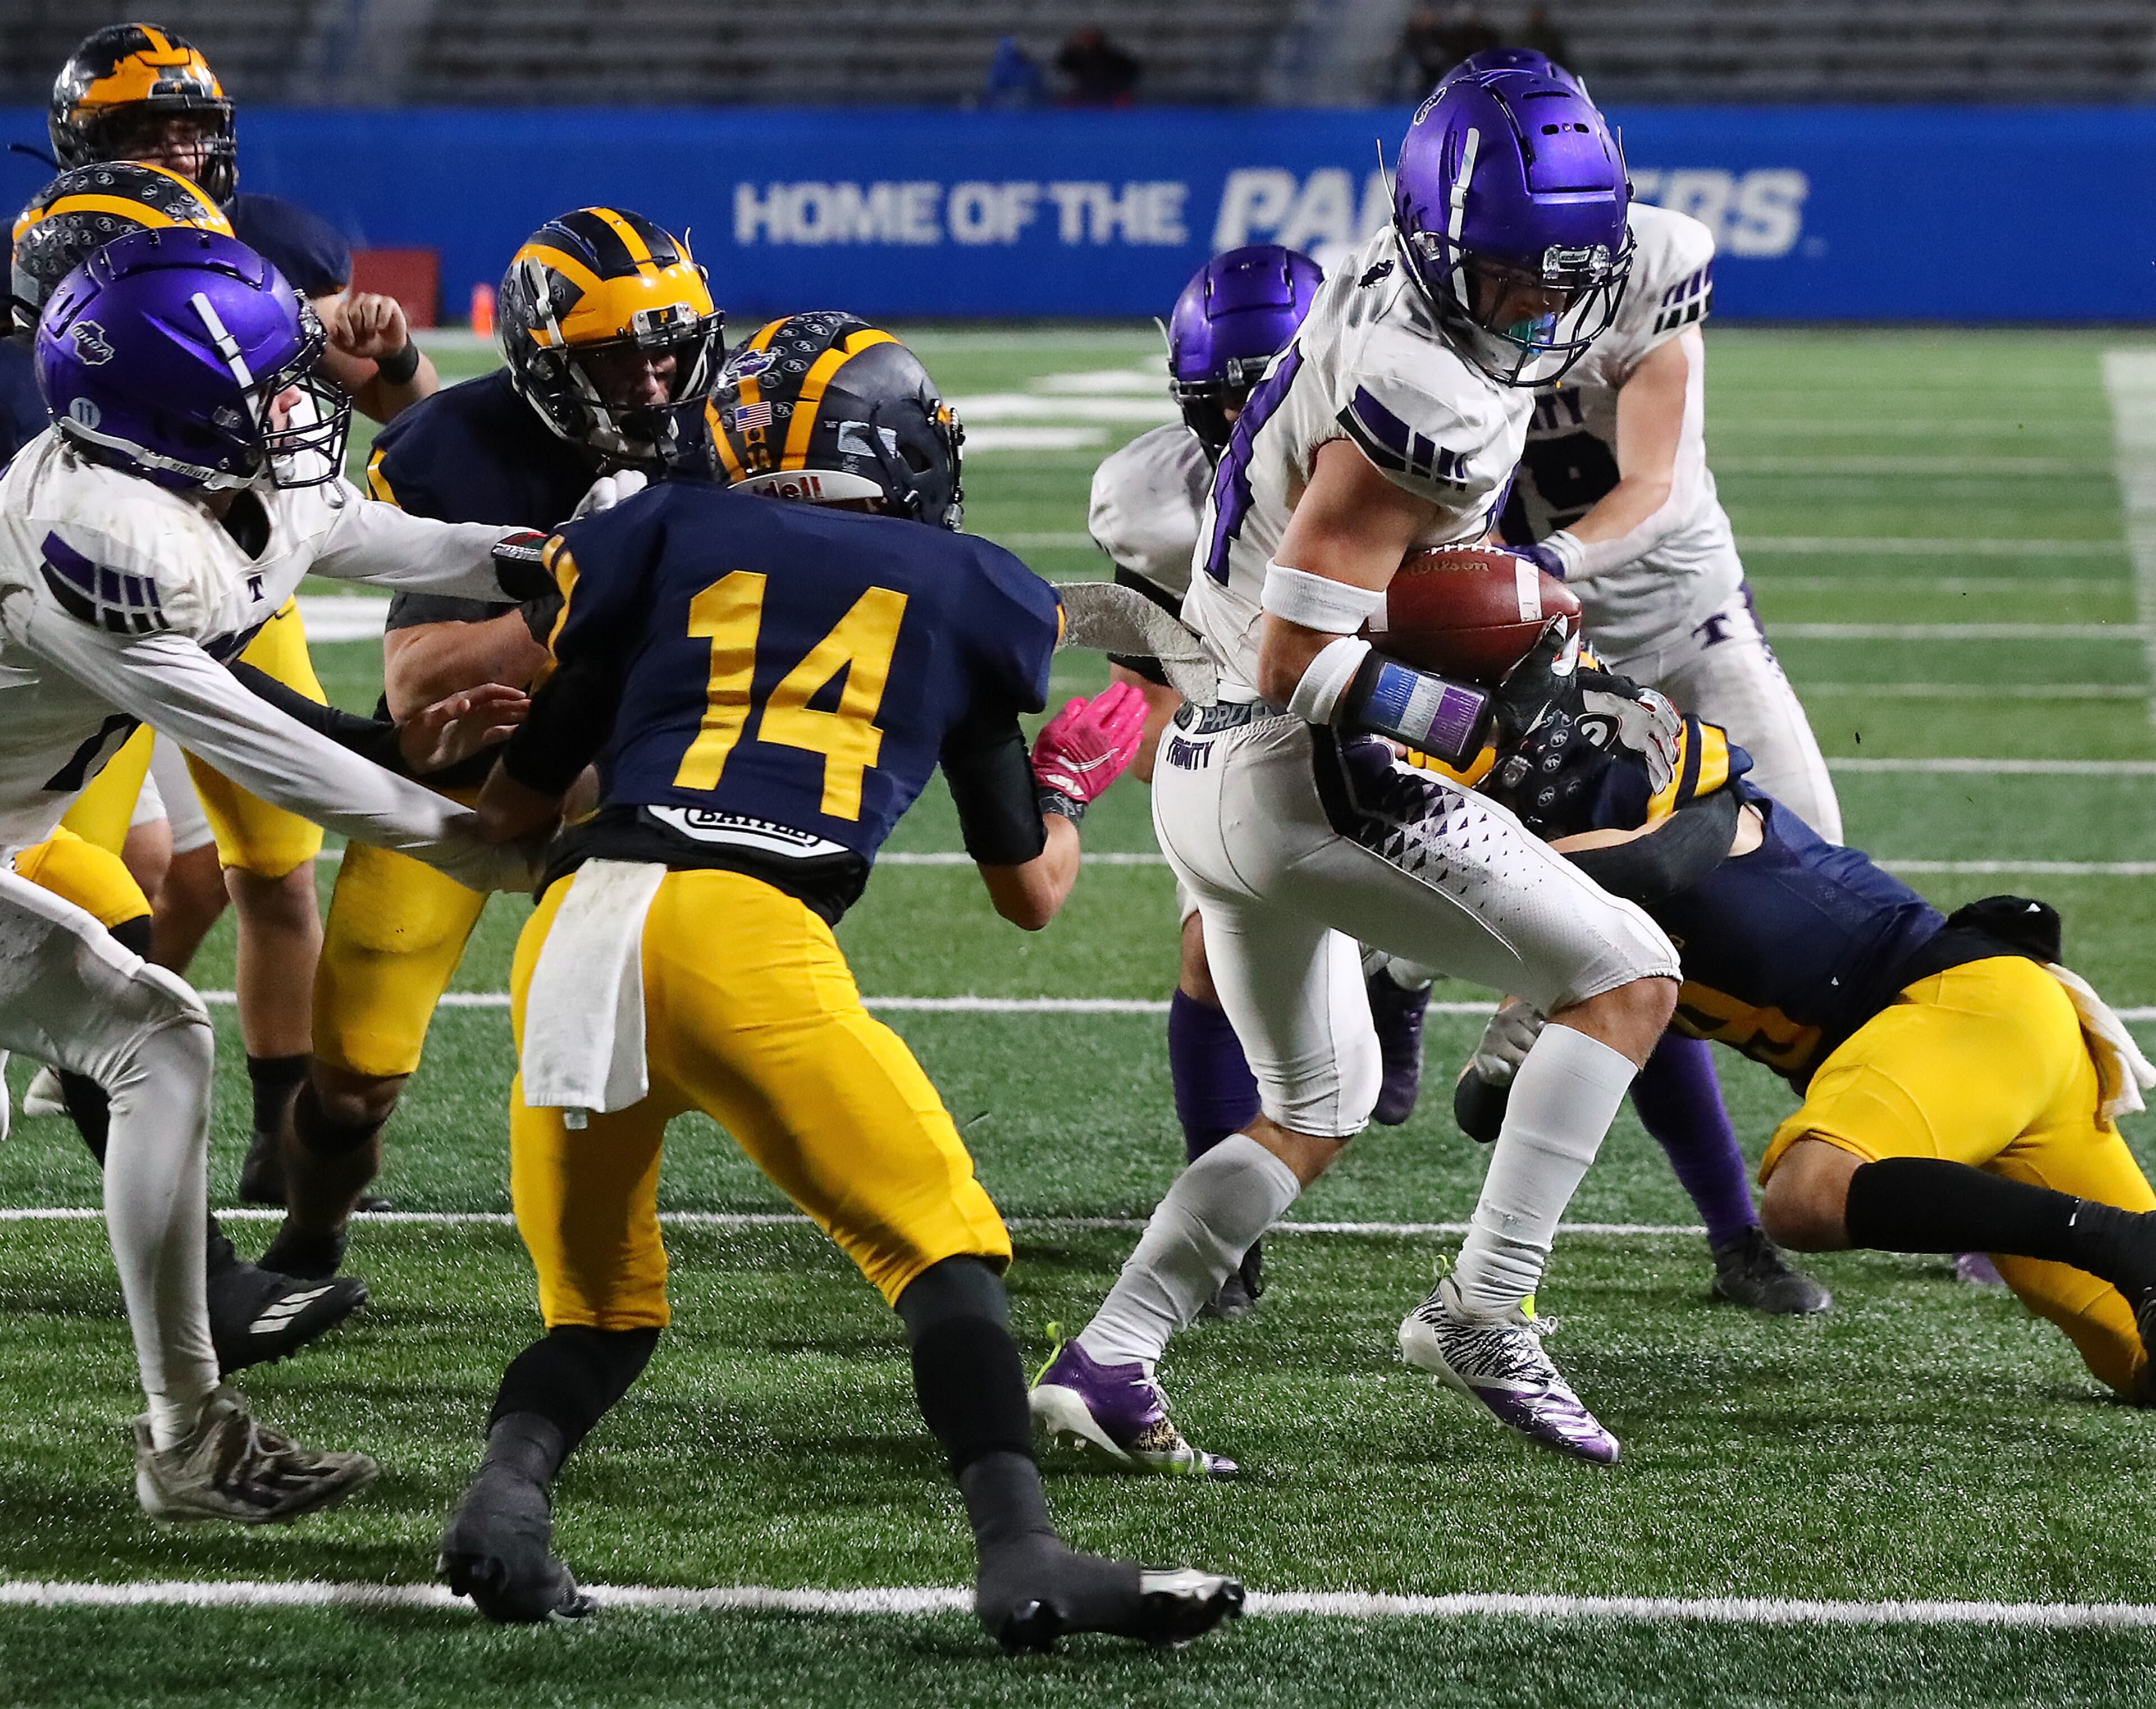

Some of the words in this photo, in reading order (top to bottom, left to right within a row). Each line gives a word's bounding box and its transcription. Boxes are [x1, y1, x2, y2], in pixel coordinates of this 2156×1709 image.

[734, 181, 944, 245] HOME
[947, 181, 1040, 245] OF
[1050, 181, 1189, 246] THE
[659, 310, 669, 324] P
[77, 403, 93, 425] 11
[247, 574, 264, 603] T
[1691, 612, 1734, 650] T
[673, 570, 908, 821] 14
